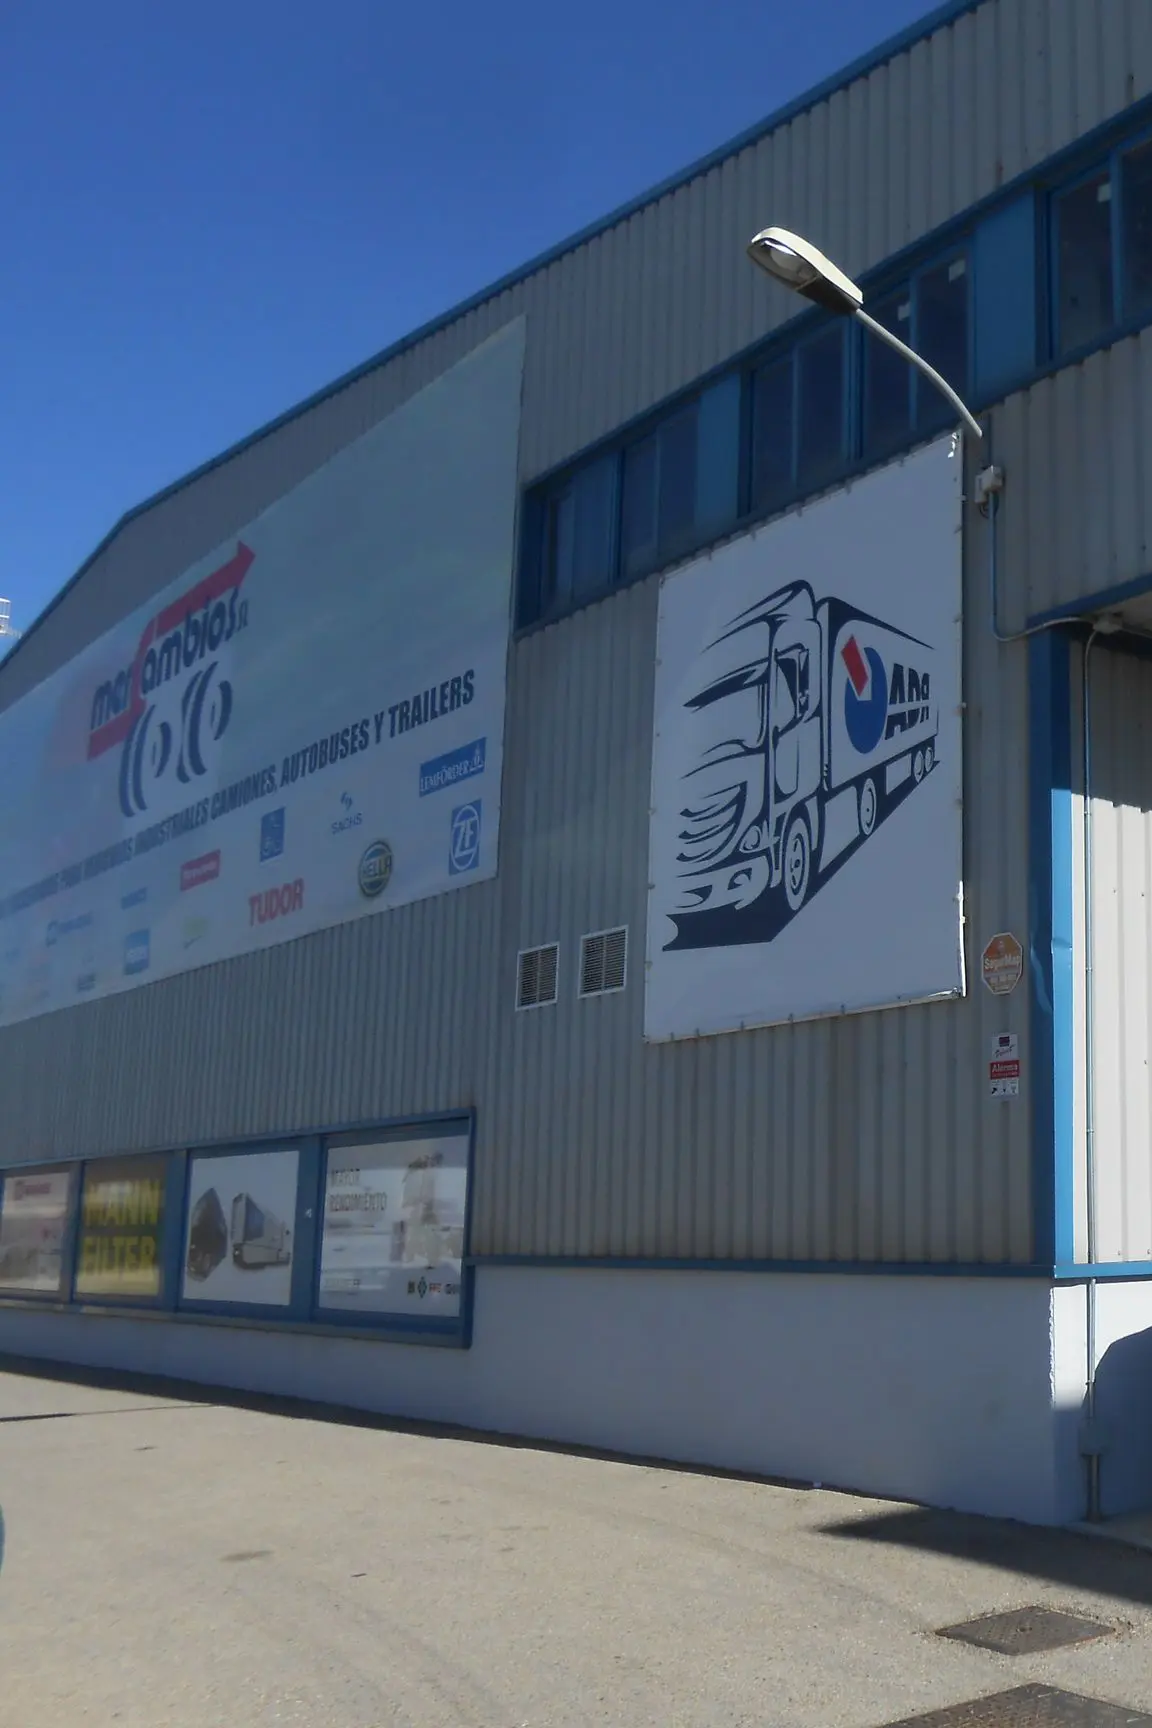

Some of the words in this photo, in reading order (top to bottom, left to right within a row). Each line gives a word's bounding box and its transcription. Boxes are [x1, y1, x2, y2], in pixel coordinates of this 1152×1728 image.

[210, 763, 278, 820] CAMIONES,
[280, 718, 370, 788] AUTOBUSES
[374, 711, 384, 745] Y
[388, 669, 475, 739] TRAILERS
[330, 812, 363, 836] SACHS
[453, 814, 479, 859] ZF
[248, 878, 304, 925] TUDOR
